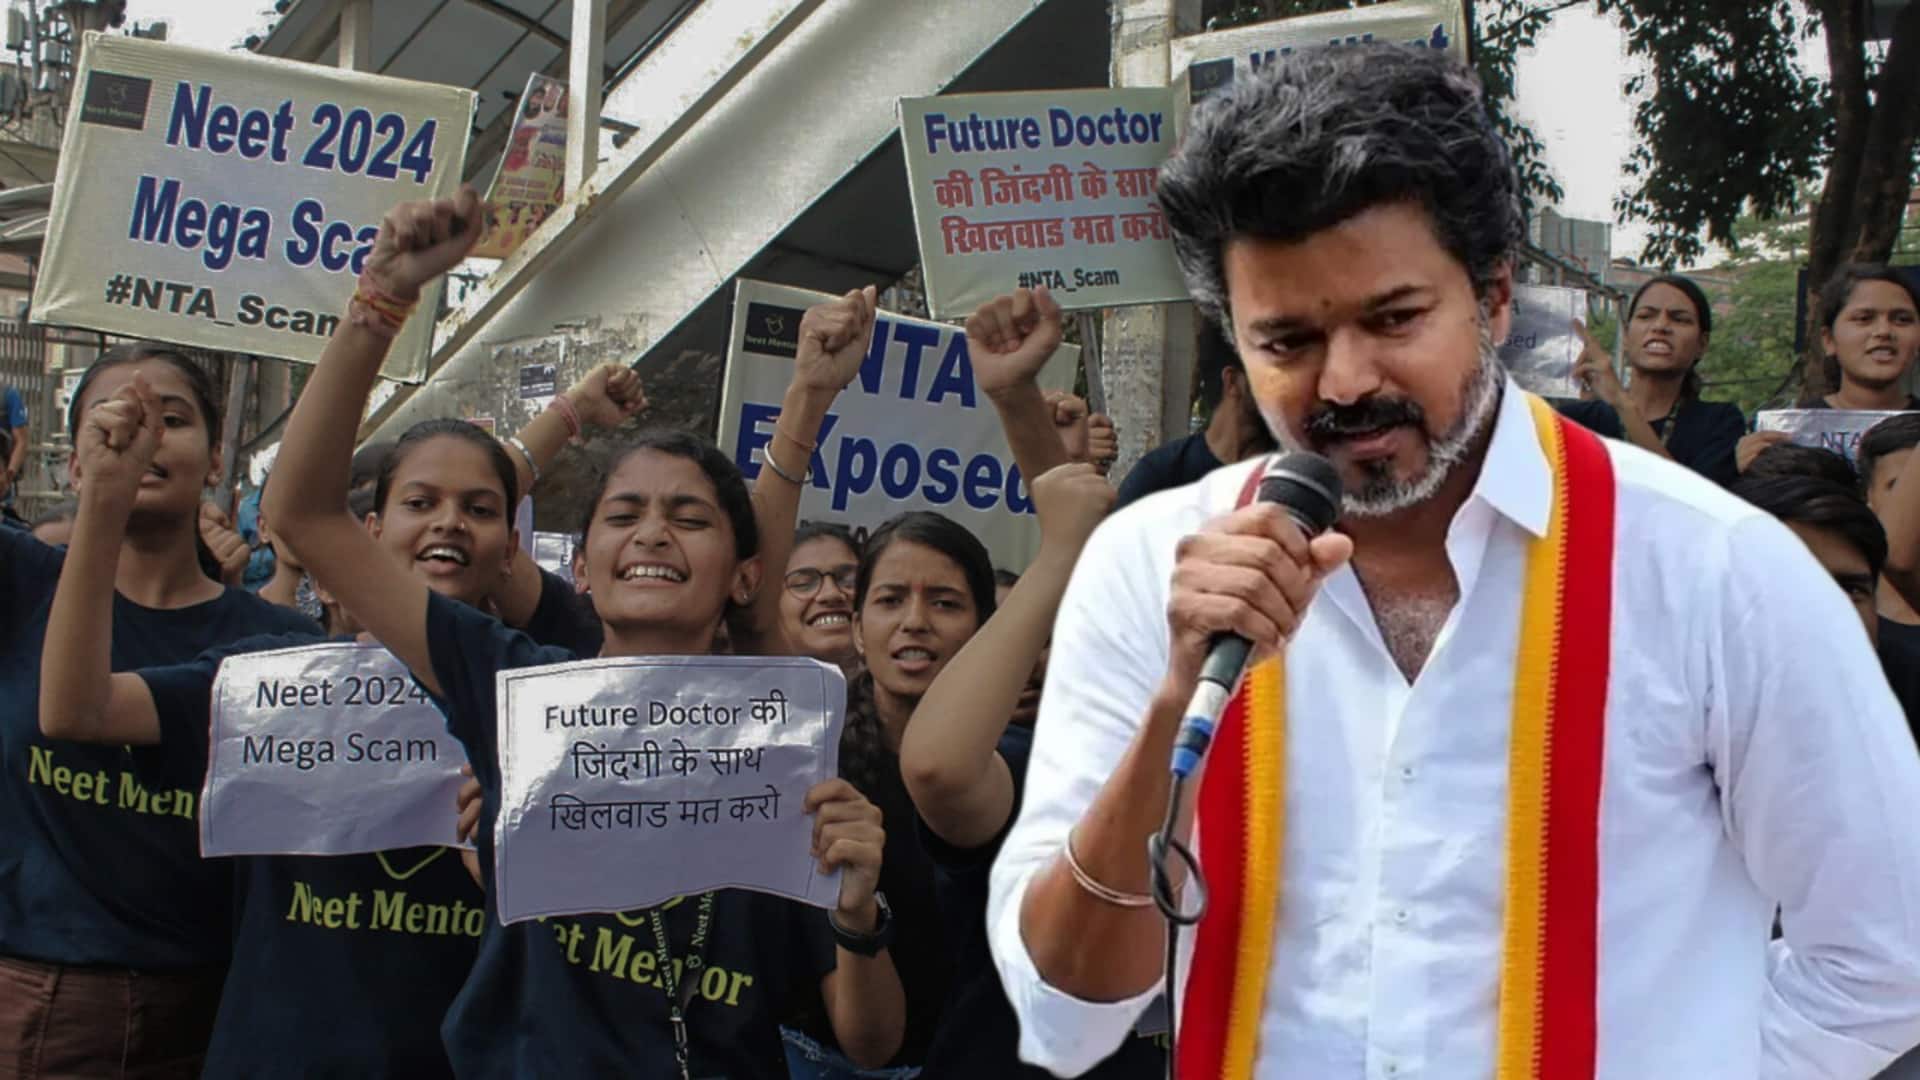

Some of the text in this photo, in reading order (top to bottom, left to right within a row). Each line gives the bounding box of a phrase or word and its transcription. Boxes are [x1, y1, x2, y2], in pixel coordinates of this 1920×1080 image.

[166, 81, 294, 162] Neet
[303, 103, 437, 184] 2024
[924, 107, 1163, 154] Future Doctor
[933, 169, 973, 208] की
[979, 164, 1073, 206] जिंदगी
[1078, 162, 1107, 199] के
[129, 175, 271, 271] Mega
[285, 199, 380, 275] Sca
[941, 215, 1066, 254] खिलवाड
[1070, 213, 1115, 245] मत
[1018, 268, 1120, 292] #NTA_Scam
[256, 675, 428, 708] Neet 2024
[545, 689, 788, 730] Future Doctor की
[243, 732, 437, 770] Mega Scam
[571, 738, 764, 779] जिंदगी के साथ
[27, 744, 110, 805] Neet
[549, 784, 781, 831] खिलवाड मत करो
[286, 881, 485, 937] Neet Mento
